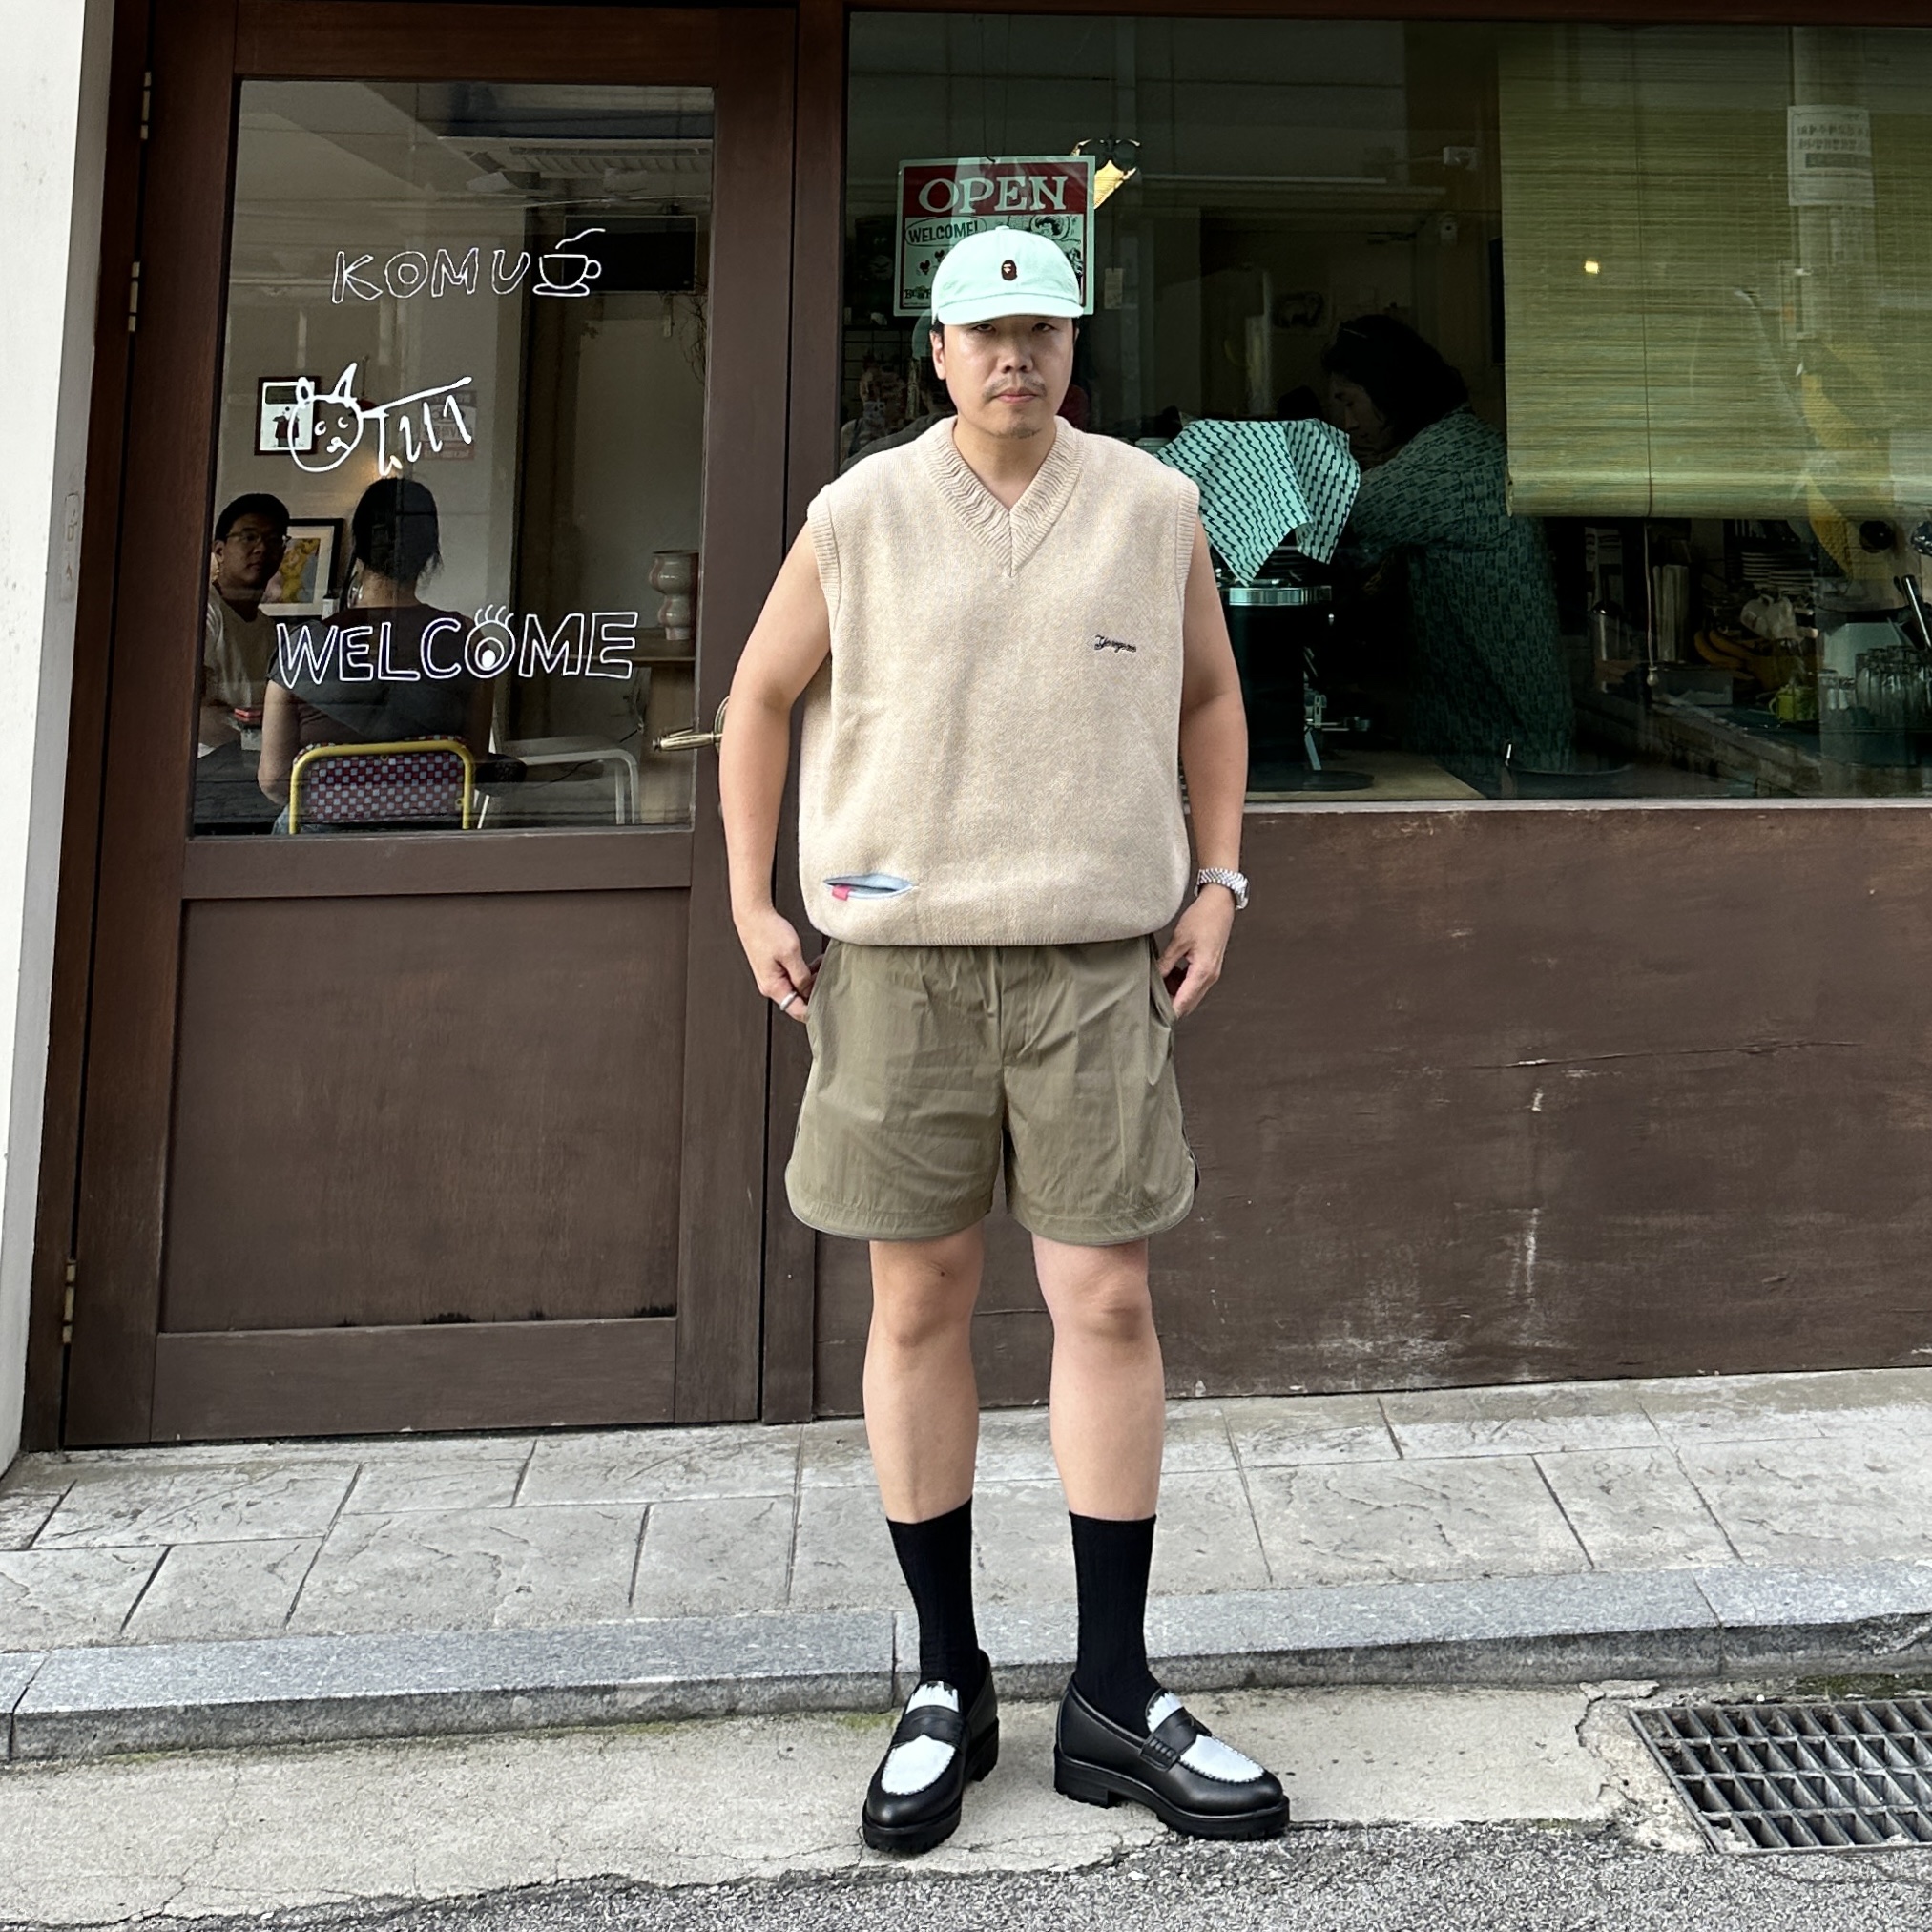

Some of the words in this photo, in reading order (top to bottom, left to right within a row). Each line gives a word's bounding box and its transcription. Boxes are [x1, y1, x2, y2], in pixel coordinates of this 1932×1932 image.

[918, 175, 1069, 215] OPEN
[331, 247, 530, 303] KOMU
[276, 608, 638, 689] WELCOME
